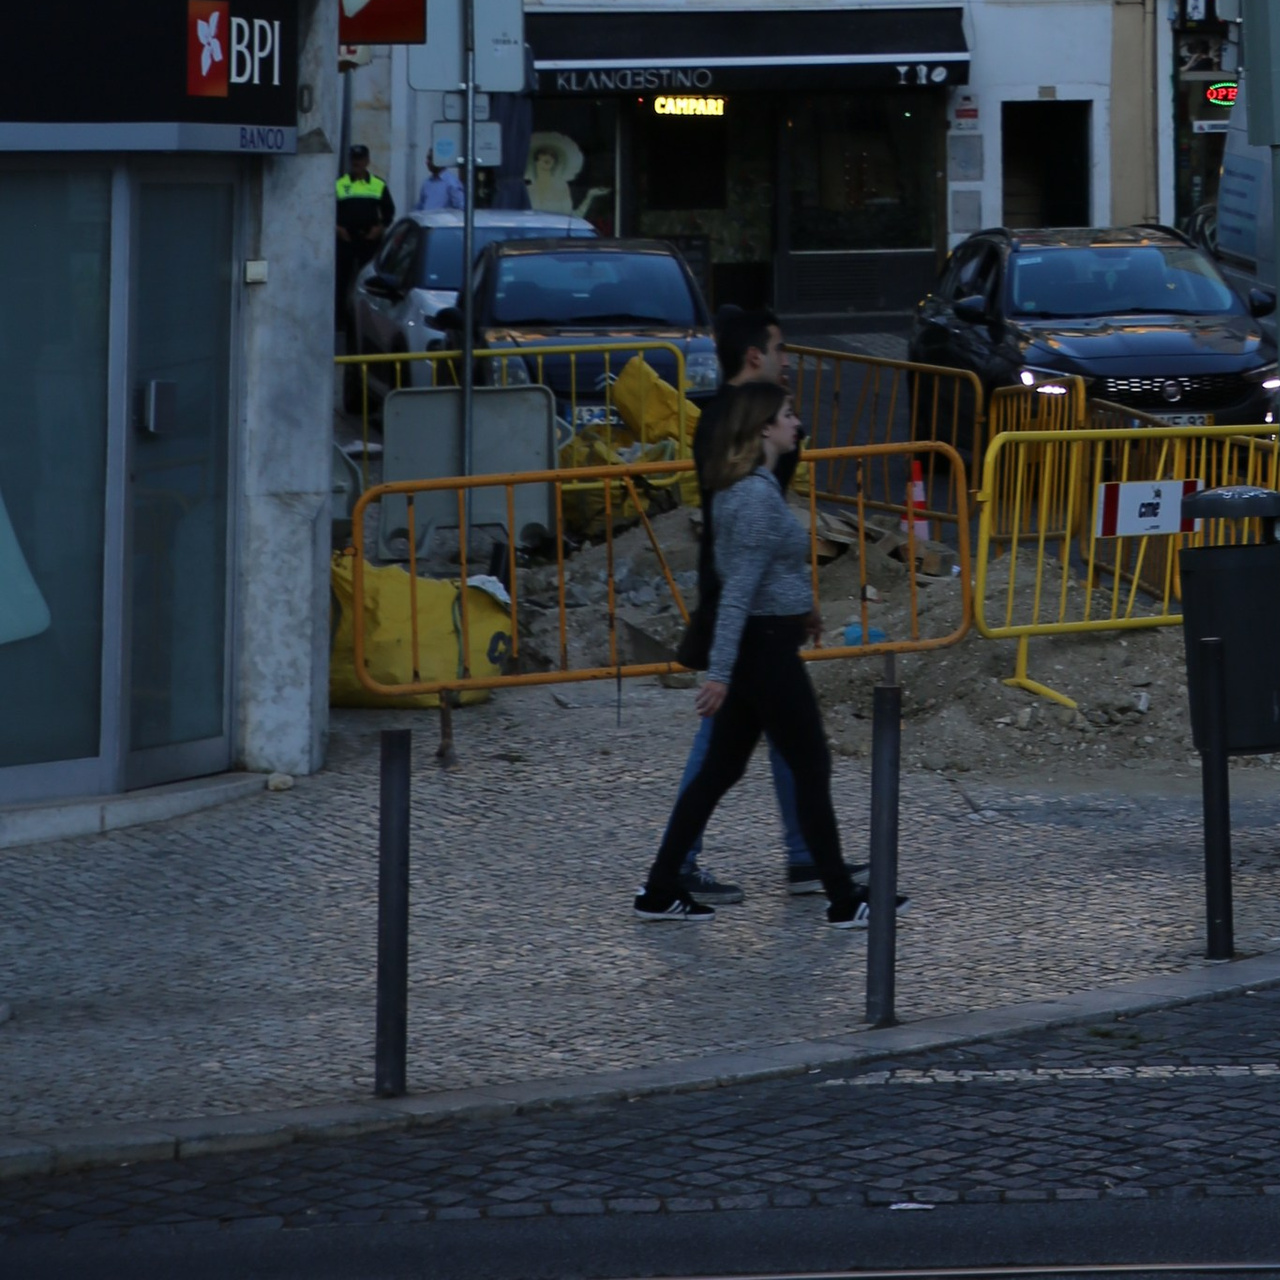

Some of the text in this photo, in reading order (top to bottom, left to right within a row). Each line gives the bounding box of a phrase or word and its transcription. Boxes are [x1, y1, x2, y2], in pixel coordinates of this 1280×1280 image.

[230, 16, 281, 85] BPI
[1207, 88, 1238, 100] OPE
[654, 96, 724, 116] CAMPARI
[239, 126, 285, 150] BANCO
